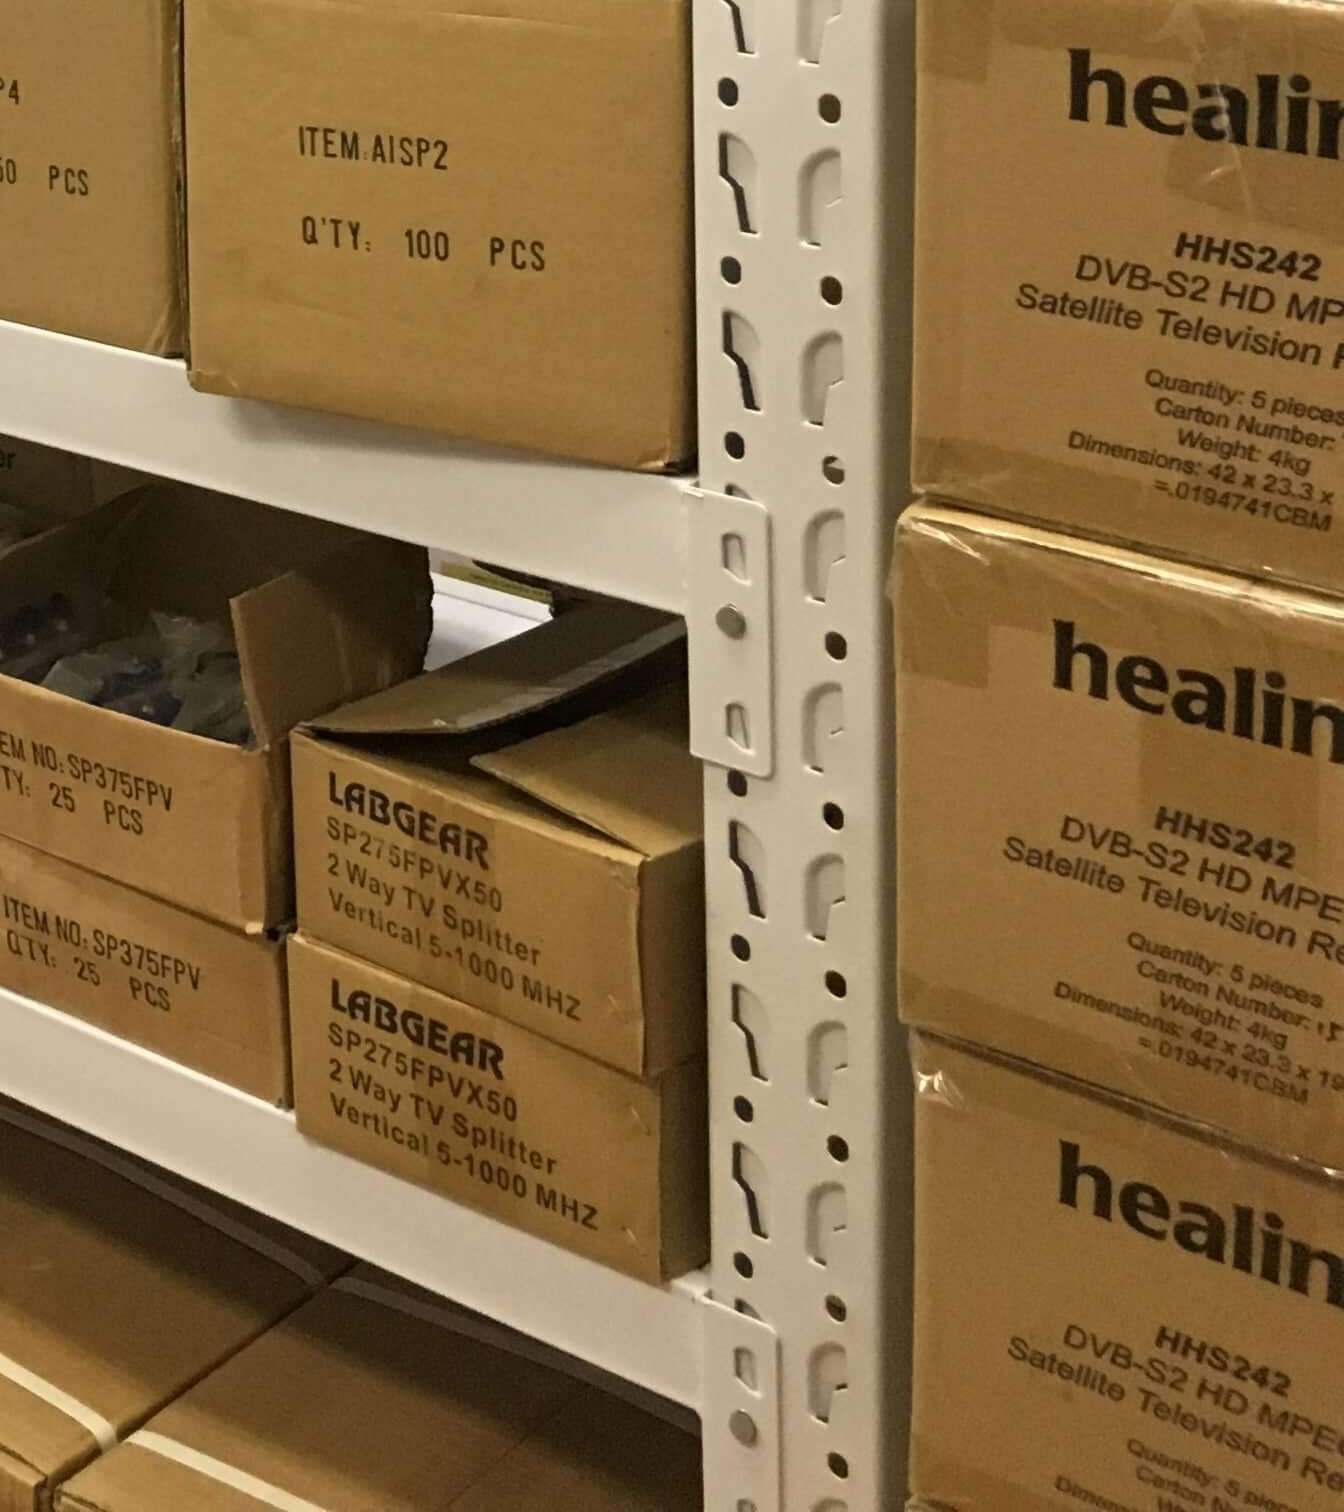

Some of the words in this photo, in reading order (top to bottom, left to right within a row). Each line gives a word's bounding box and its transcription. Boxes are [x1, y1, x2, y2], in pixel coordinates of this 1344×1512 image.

[48, 164, 90, 197] PCS
[402, 225, 451, 266] 100
[489, 235, 547, 275] PCS
[1075, 253, 1212, 304] DVB-S2
[1220, 281, 1276, 315] HD
[1174, 231, 1322, 283] HHS242
[1015, 282, 1143, 332] Satellite
[1156, 311, 1323, 366] Television
[1145, 368, 1244, 407] Quantity:
[1251, 390, 1266, 409] 5
[1155, 396, 1230, 429] Carton
[1236, 414, 1335, 452] Number:
[1068, 430, 1204, 477] Dimensions:
[1208, 463, 1237, 485] 42
[1263, 473, 1314, 501] 23.3
[1178, 427, 1261, 463] Weight:
[1268, 449, 1311, 477] 4kg
[49, 783, 76, 813] 25
[103, 800, 143, 835] PCS
[329, 771, 489, 871] LABGEAR
[1155, 805, 1297, 869] HHS242
[327, 816, 502, 912] SP275FPVX50
[1003, 835, 1126, 896] Satellite
[1137, 874, 1298, 950] Television
[1060, 815, 1188, 876] DVB-S2
[1198, 856, 1253, 894] HD
[3, 895, 50, 936] ITEM
[328, 853, 339, 877] 2
[346, 859, 395, 906] Way
[402, 885, 435, 918] TV
[443, 904, 541, 966] Splitter
[74, 956, 101, 986] 25
[129, 976, 171, 1012] PCS
[328, 887, 421, 949] Vertical
[429, 935, 514, 991] 5-1000
[522, 975, 582, 1022] MHZ
[1127, 931, 1223, 976] Quantity:
[1231, 964, 1245, 983] 5
[1248, 971, 1325, 1009] pieces
[331, 978, 504, 1080] LABGEAR
[1054, 981, 1184, 1039] Dimensions:
[1190, 1026, 1218, 1050] 42
[1241, 1044, 1292, 1075] 23.3
[1137, 959, 1210, 997] Carton
[1215, 984, 1310, 1032] Number:
[1159, 990, 1242, 1032] Weight:
[1247, 1019, 1289, 1052] 4kg
[328, 1022, 518, 1122] SP275FPVX50
[329, 1057, 342, 1082] 2
[348, 1065, 401, 1113] Way
[409, 1093, 444, 1126] TV
[451, 1112, 557, 1175] Splitter
[330, 1092, 428, 1156] Vertical
[437, 1140, 526, 1199] 5-1000
[536, 1184, 599, 1231] MHZ
[1063, 1323, 1190, 1393] DVB-S2
[1197, 1376, 1249, 1417] HD
[1155, 1325, 1292, 1399] HHS242
[1007, 1335, 1126, 1403] Satellite
[1137, 1386, 1291, 1473] Television
